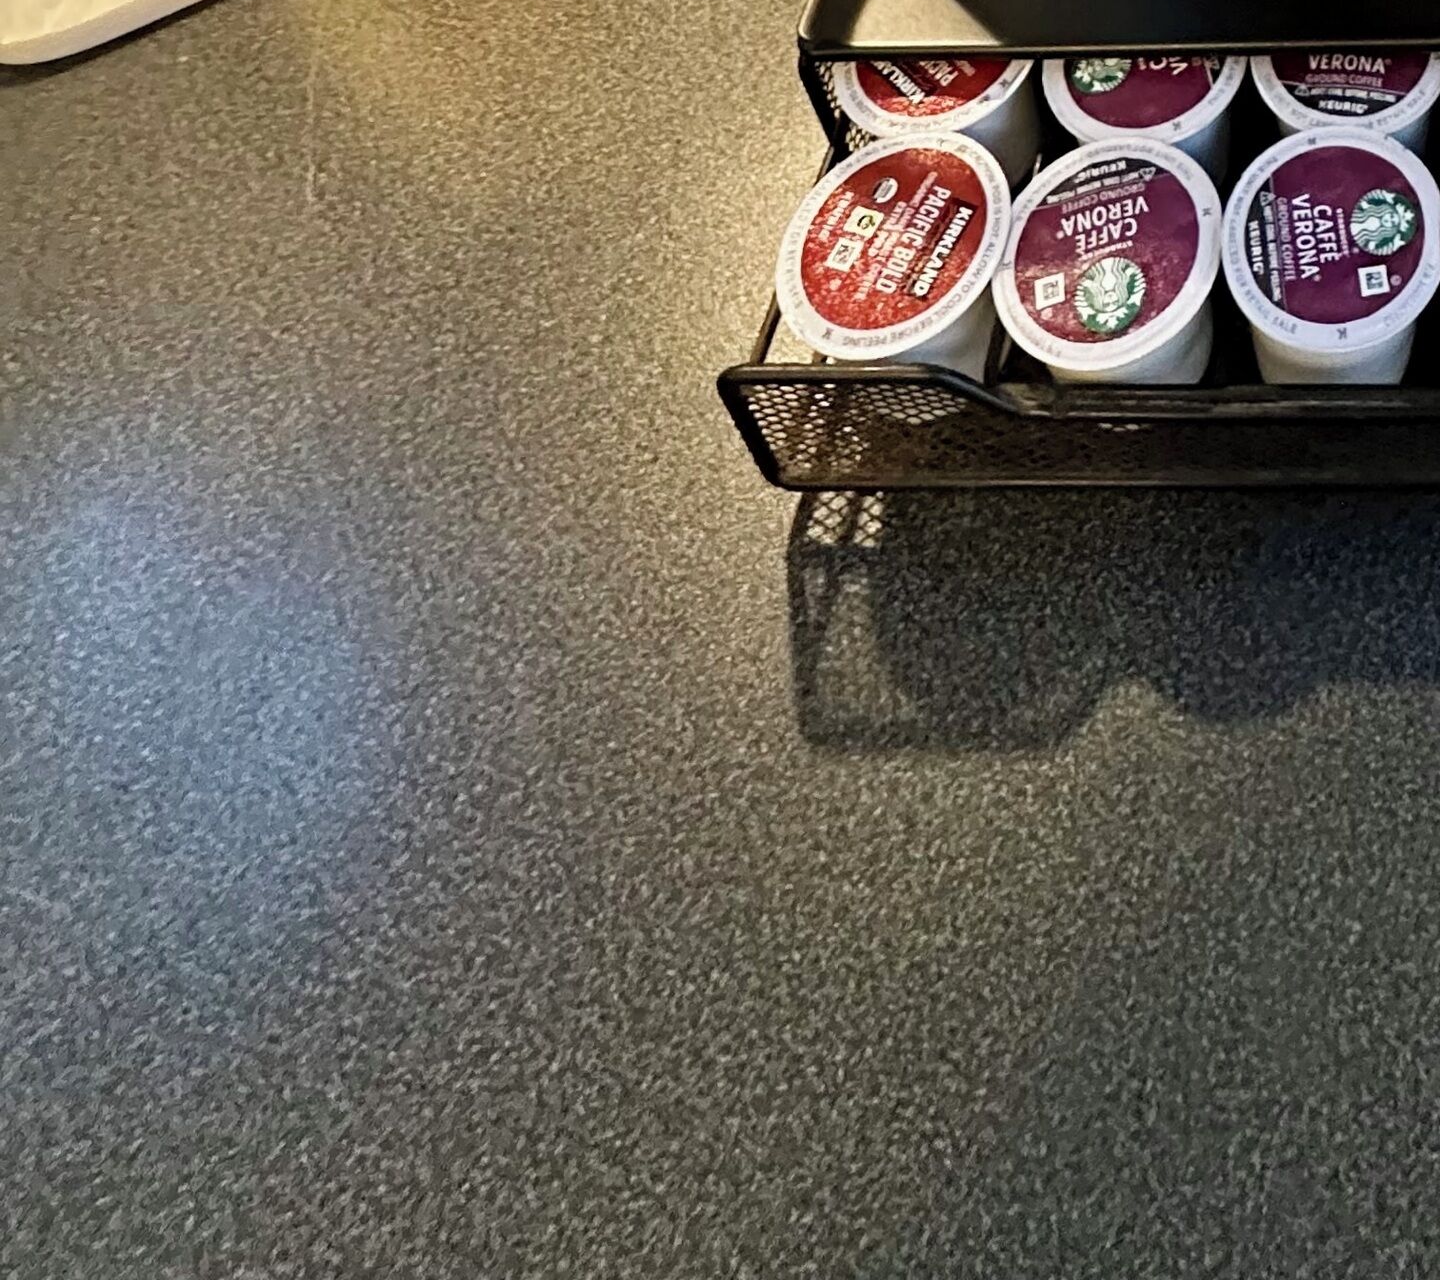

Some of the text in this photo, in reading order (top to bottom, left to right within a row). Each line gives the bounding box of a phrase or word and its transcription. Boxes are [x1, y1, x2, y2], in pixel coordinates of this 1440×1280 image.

[1308, 53, 1385, 75] VERONA
[1318, 100, 1366, 114] KEURIG
[1077, 160, 1126, 182] KEURIG
[1100, 182, 1145, 201] GROUND
[900, 186, 951, 247] PACIFIC
[1061, 196, 1148, 236] VERONA
[1062, 194, 1098, 213] COFFEE
[913, 206, 974, 297] KIRKLAND
[1075, 218, 1137, 255] CAFFÈ
[1249, 221, 1263, 271] KEURIG
[1277, 197, 1296, 280] GROUND COFFEE
[1292, 194, 1319, 278] VERONA
[1313, 205, 1341, 263] CAFFÈ
[875, 246, 916, 294] BOLD
